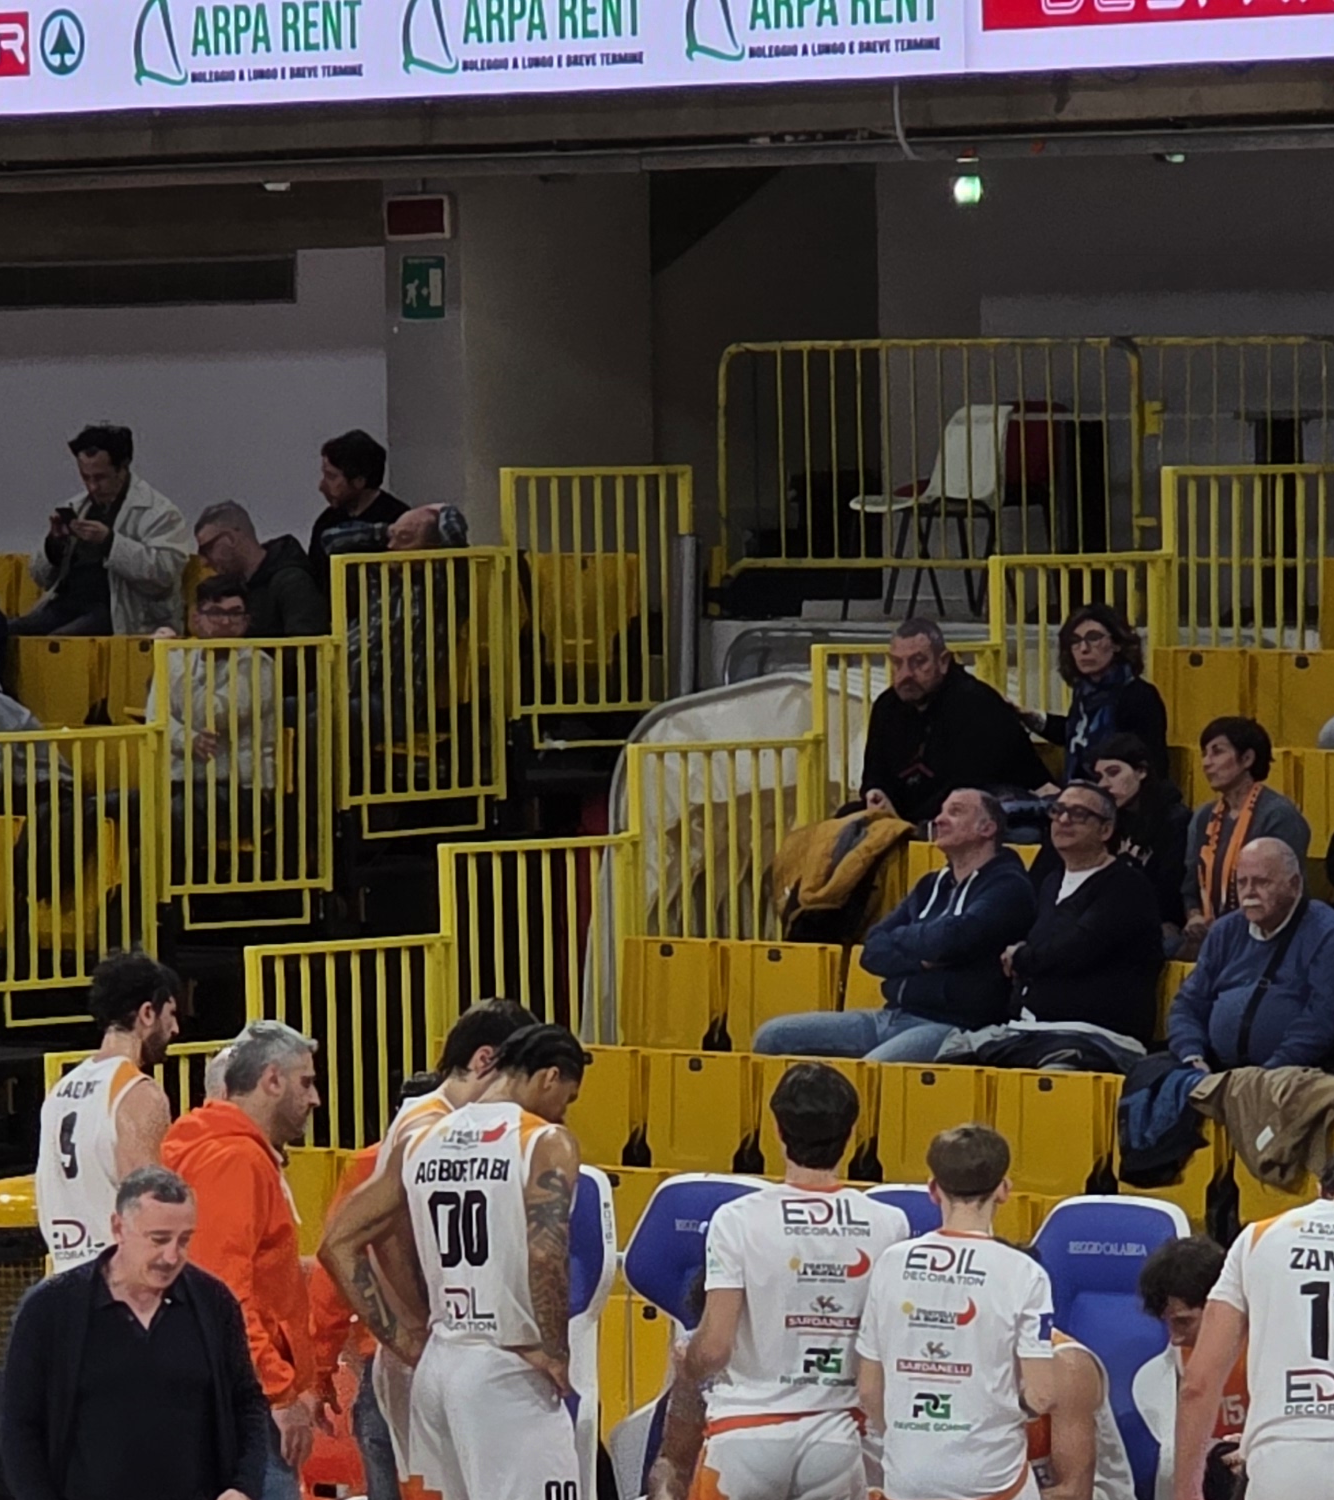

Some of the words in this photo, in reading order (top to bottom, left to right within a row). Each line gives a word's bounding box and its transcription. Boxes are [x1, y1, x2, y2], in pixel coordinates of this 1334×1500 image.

[191, 3, 271, 57] ARPA
[281, 0, 362, 52] RENT
[463, 0, 548, 44] ARPA
[558, 0, 639, 40] RENT
[781, 1198, 870, 1226] EDIL
[428, 1190, 488, 1268] 00
[784, 1226, 871, 1238] DECORATION
[905, 1244, 986, 1276] EDIL
[902, 1271, 985, 1287] DECORATION
